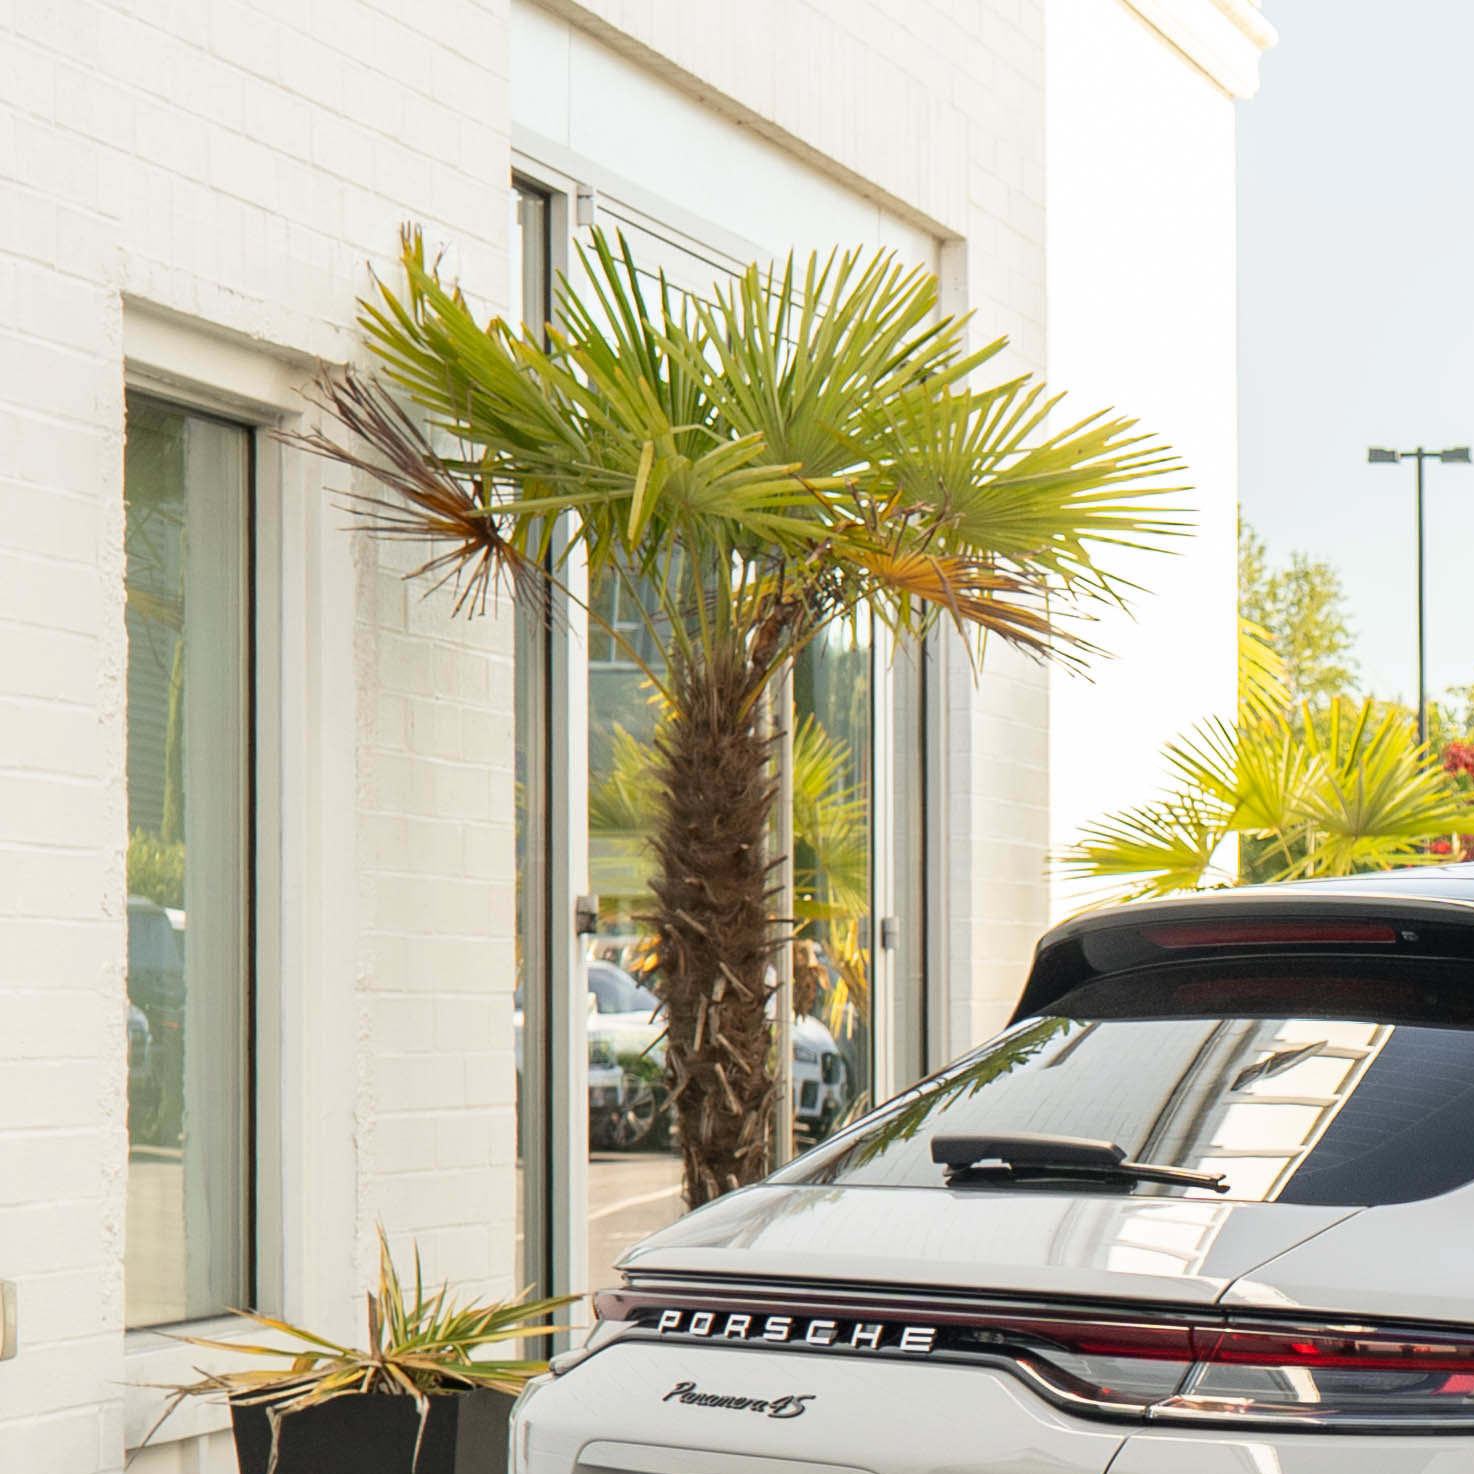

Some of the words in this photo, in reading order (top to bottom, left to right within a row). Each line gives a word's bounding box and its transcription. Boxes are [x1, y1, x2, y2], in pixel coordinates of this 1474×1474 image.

[658, 1310, 938, 1352] PORSCHE
[662, 1381, 768, 1413] Panamera
[767, 1395, 816, 1419] 4S
